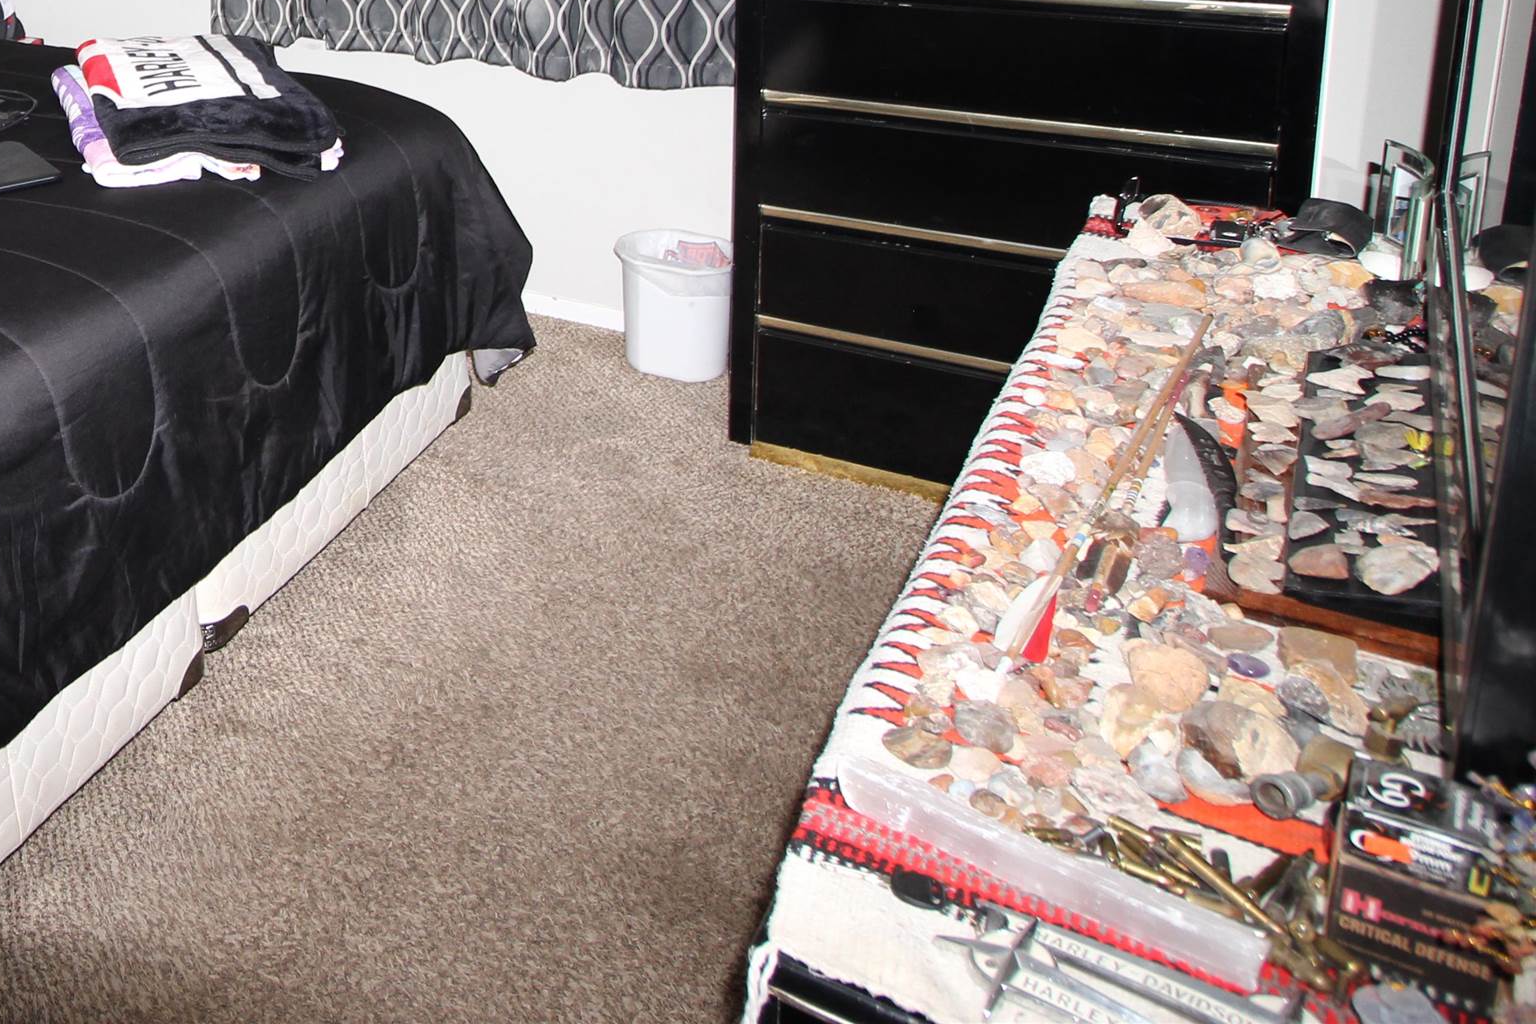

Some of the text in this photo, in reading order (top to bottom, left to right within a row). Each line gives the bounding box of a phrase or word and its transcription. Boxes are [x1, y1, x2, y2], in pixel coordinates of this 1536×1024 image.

[1036, 929, 1254, 1024] HARLEY-DAVIDSO
[1338, 914, 1412, 954] CRITICAL
[1415, 943, 1492, 982] DEFENSE
